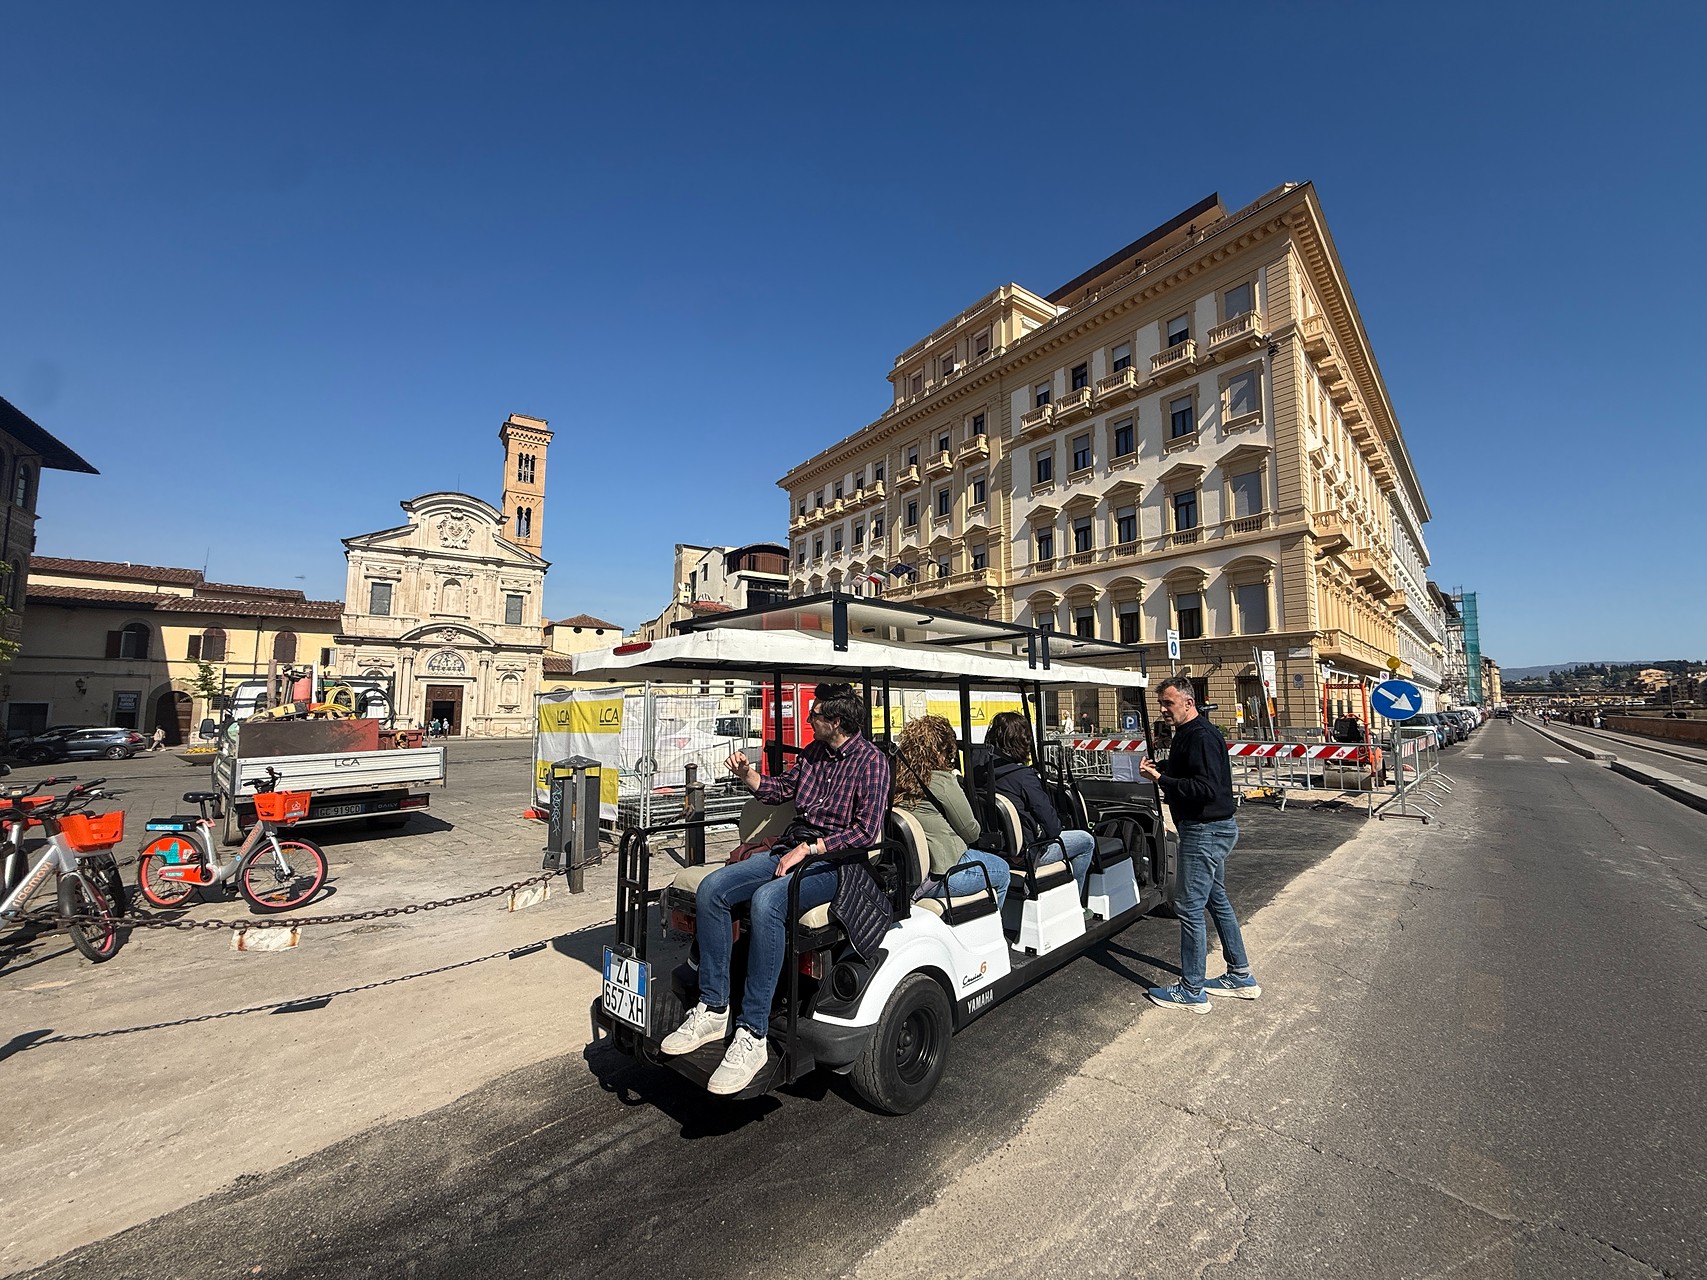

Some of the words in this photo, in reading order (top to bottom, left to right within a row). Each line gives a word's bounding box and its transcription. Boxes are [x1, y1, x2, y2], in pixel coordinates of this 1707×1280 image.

[557, 710, 569, 723] LCA
[599, 707, 618, 722] LCA
[1126, 716, 1134, 728] P
[335, 758, 360, 768] LCA
[12, 861, 53, 907] ridemovi
[617, 958, 630, 988] ZA
[606, 983, 625, 1013] 657
[628, 993, 644, 1025] XH
[967, 989, 994, 1014] YAMAHA
